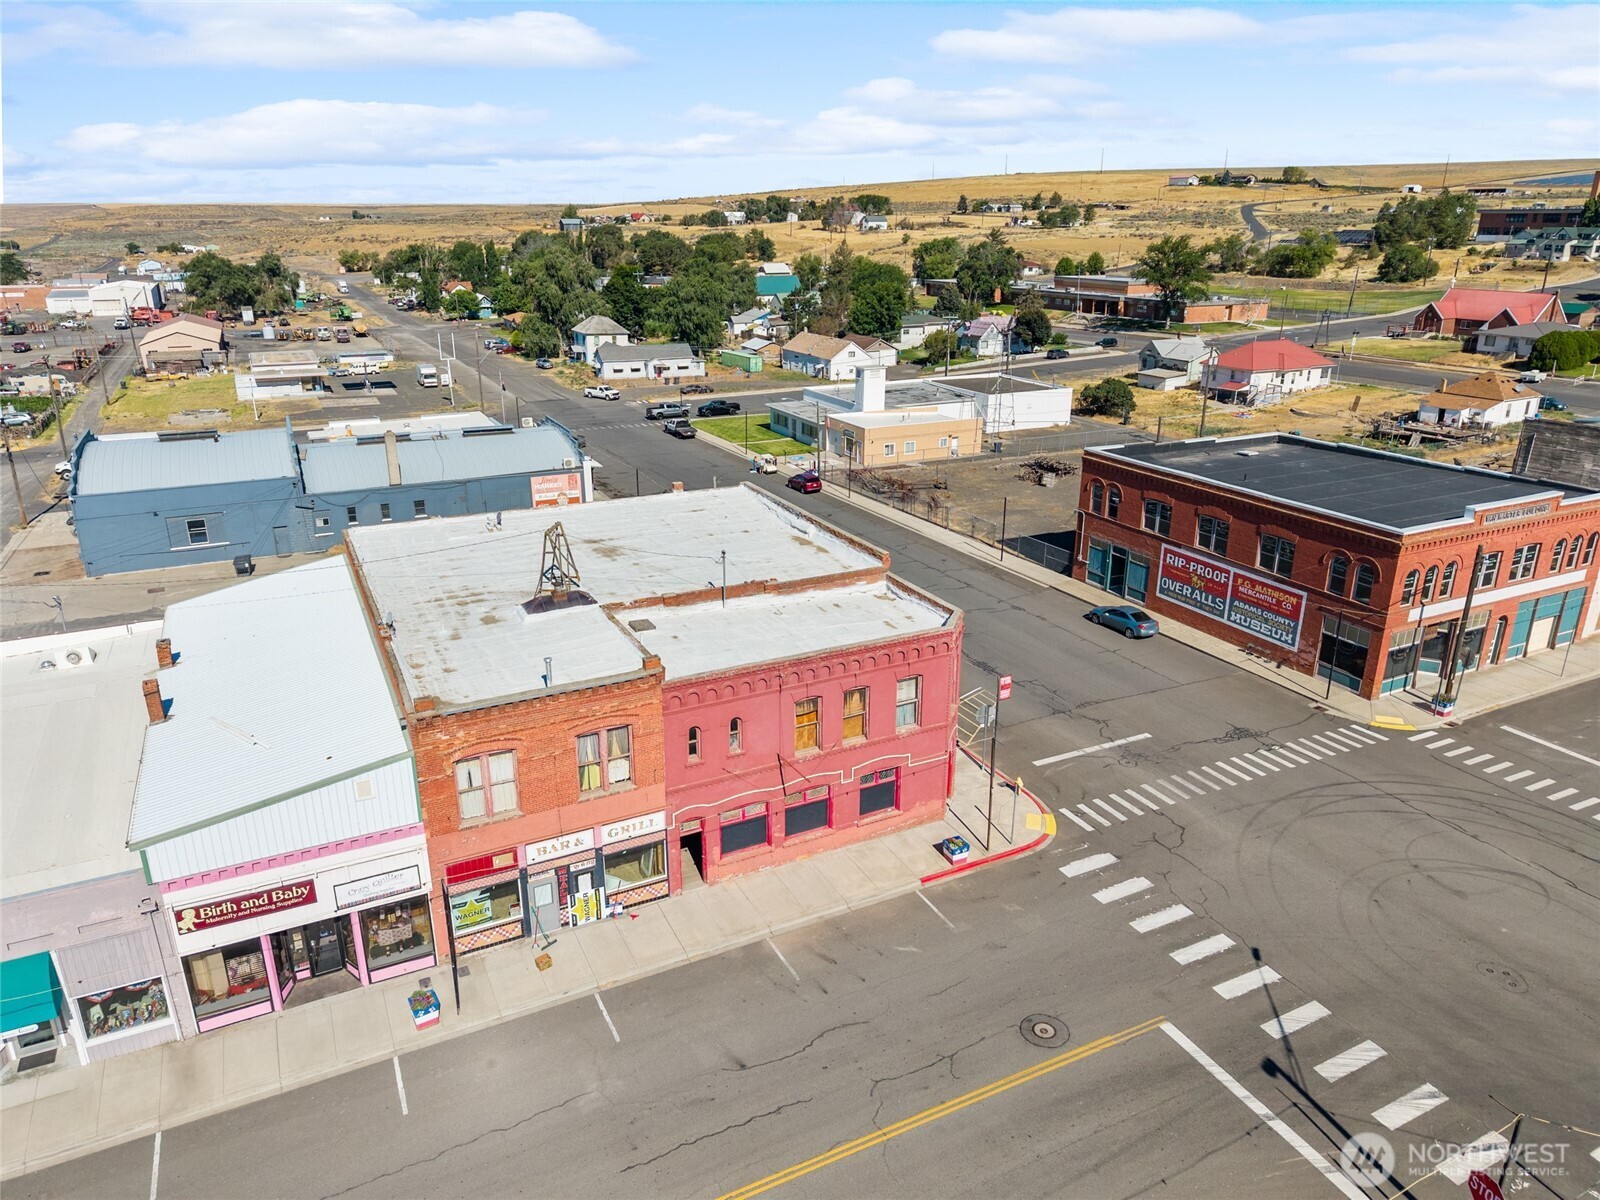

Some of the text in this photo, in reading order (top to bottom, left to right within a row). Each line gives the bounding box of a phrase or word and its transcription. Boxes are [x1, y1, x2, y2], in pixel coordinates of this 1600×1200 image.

[1166, 553, 1229, 584] RIP-PROOF
[1161, 577, 1224, 610] OVERALLS
[1238, 586, 1277, 605] MERCANTILE
[1282, 601, 1293, 610] CO.
[1255, 584, 1298, 605] MATHISON
[1230, 611, 1293, 643] MUSEUM
[1231, 606, 1294, 633] HISTORICAL SOCIETY
[1233, 600, 1296, 627] ADAMS COUNTY
[607, 818, 659, 839] GRILL
[536, 836, 585, 857] BAR &
[199, 885, 310, 919] Birth and Baby
[205, 897, 304, 924] Maternity and Nursing Supplies
[455, 906, 490, 921] WAGNER
[582, 892, 591, 923] WAGNER
